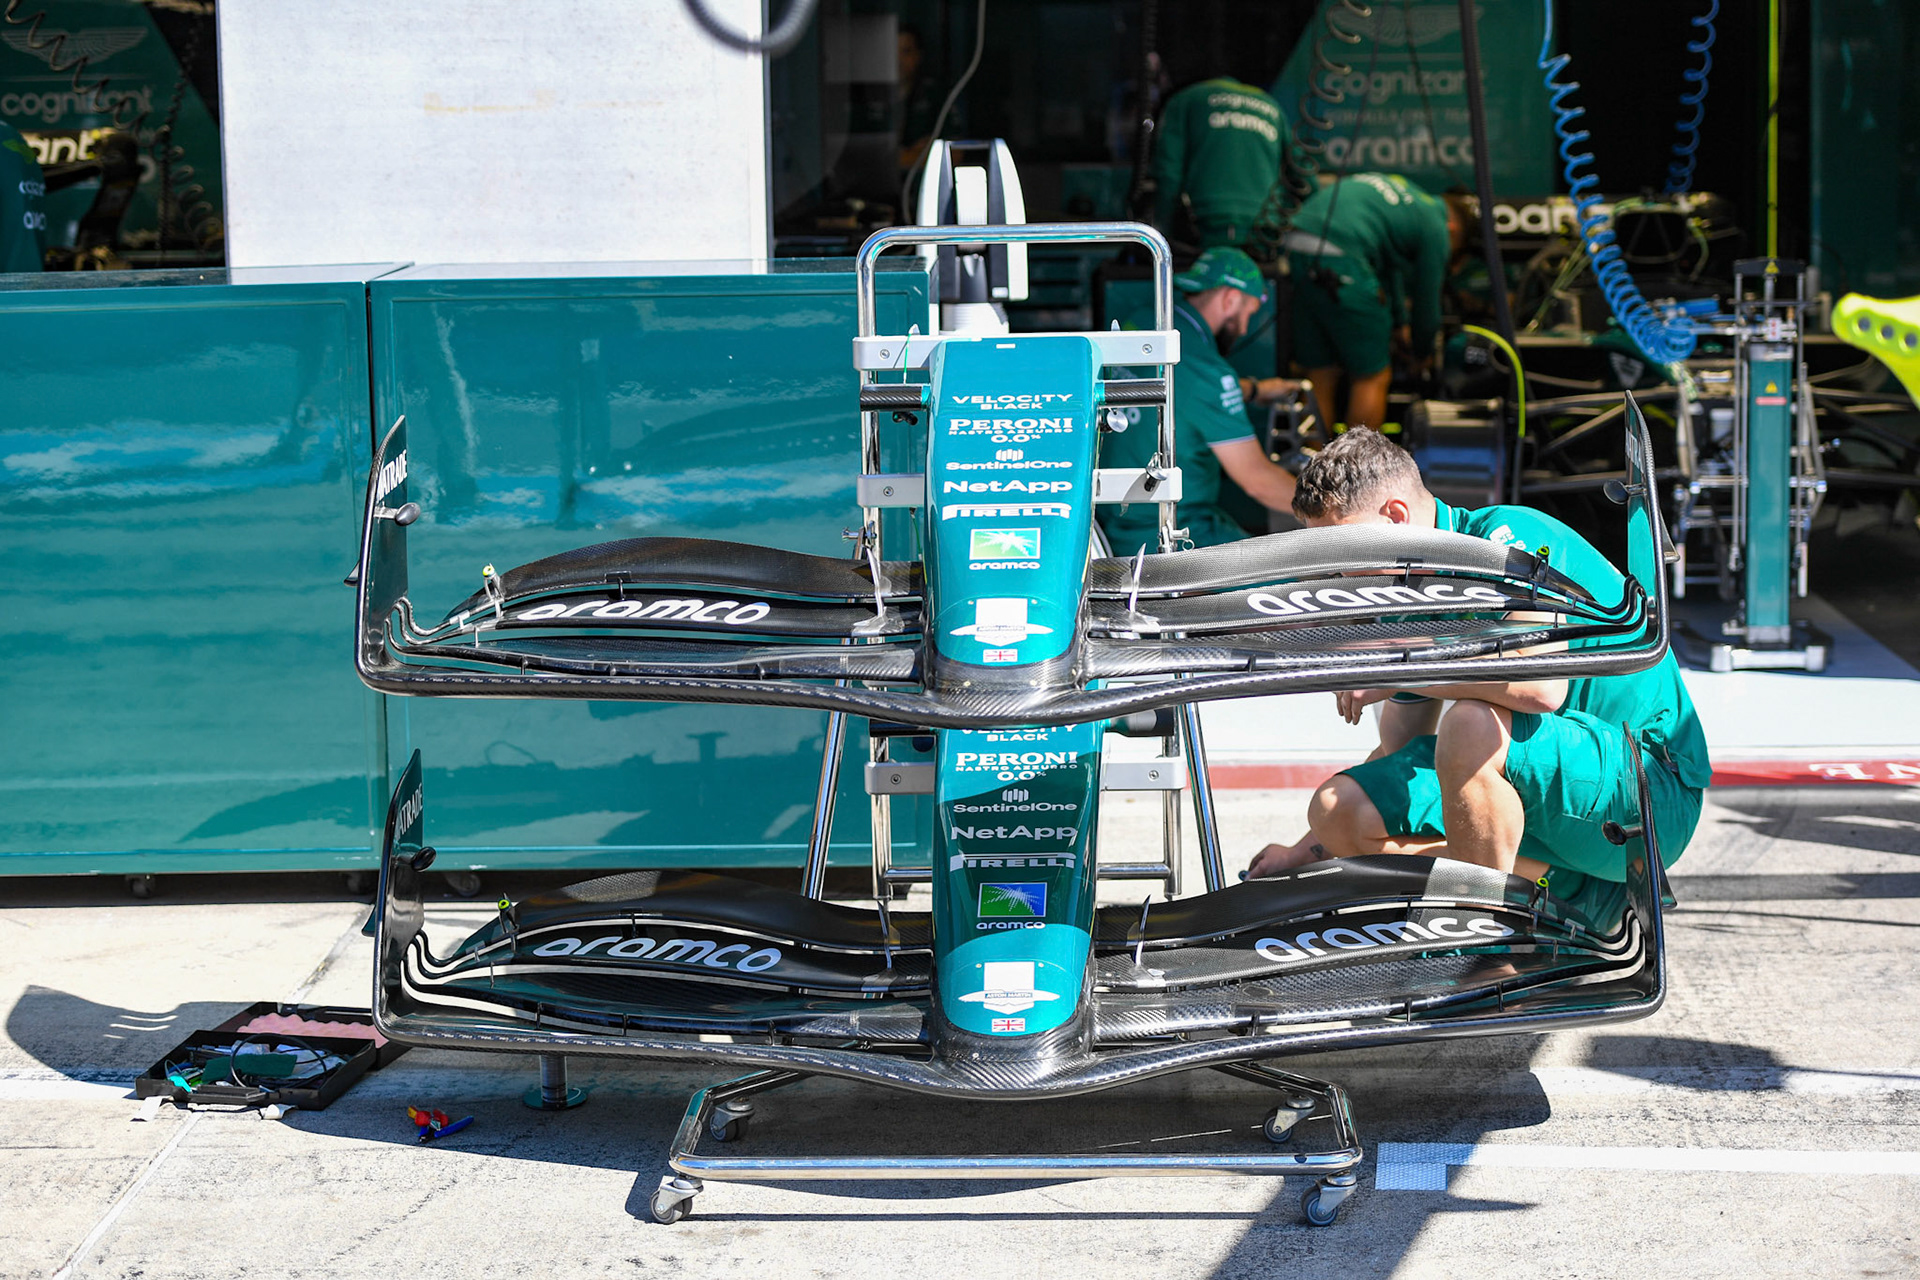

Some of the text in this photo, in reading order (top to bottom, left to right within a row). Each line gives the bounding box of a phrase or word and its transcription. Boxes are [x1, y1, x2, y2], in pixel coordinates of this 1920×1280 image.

[952, 394, 1073, 404] VELOCITY
[980, 402, 1043, 411] BLACK
[949, 418, 1073, 431] PERONI
[945, 460, 1073, 471] SentinelOne
[943, 480, 1073, 494] NetApp
[942, 502, 1072, 521] PIRELLI
[969, 561, 1041, 571] aramco
[1247, 584, 1512, 616] aramco
[517, 599, 771, 626] aramco
[986, 733, 1049, 742] BLACK
[956, 751, 1078, 767] PERONI
[997, 770, 1047, 782] 0.0%
[953, 802, 1077, 813] SentinelOne
[951, 825, 1077, 840] NetApp
[950, 853, 1076, 872] PIRELLI
[976, 921, 1046, 930] aramco
[1254, 916, 1515, 963] aramco
[532, 936, 782, 973] aramco
